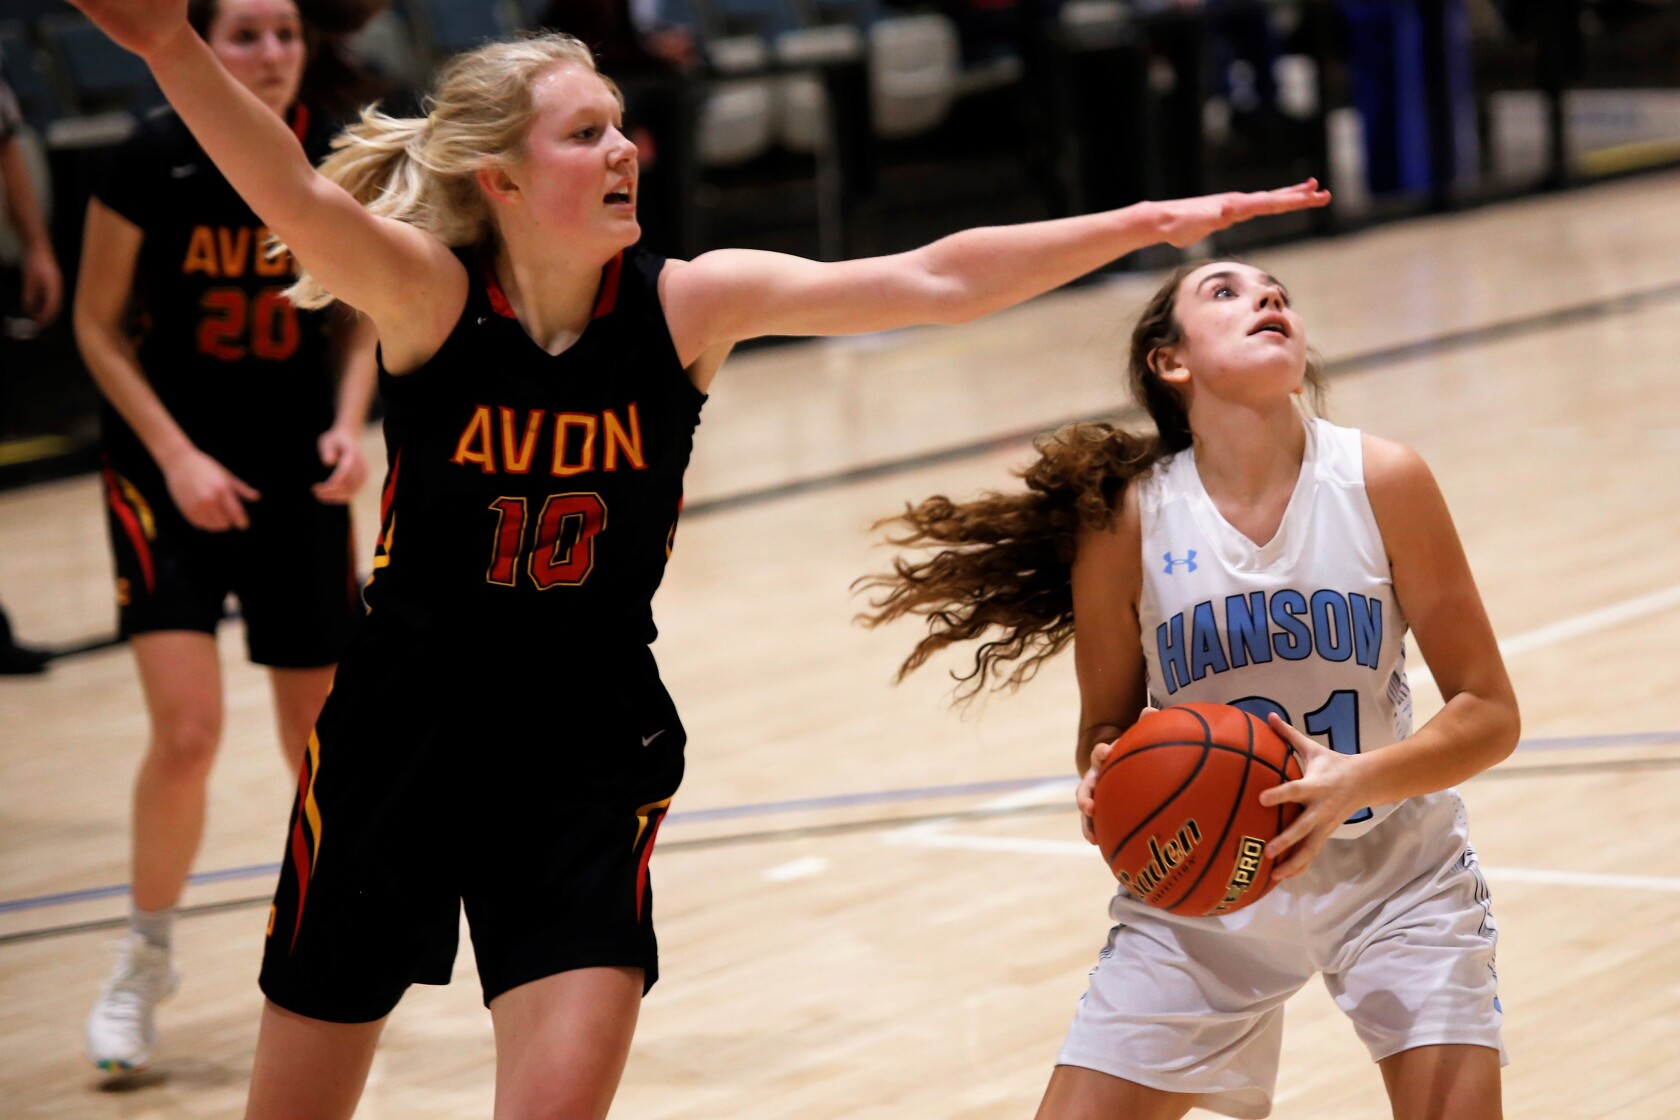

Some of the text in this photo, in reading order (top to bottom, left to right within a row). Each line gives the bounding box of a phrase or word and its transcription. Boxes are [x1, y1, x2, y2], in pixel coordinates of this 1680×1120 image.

[181, 224, 292, 279] AVO
[196, 285, 300, 361] 20
[448, 401, 648, 478] AVON
[486, 491, 608, 591] 10
[1156, 588, 1383, 696] HANSON
[1226, 689, 1374, 825] 1
[1234, 839, 1263, 884] PRO
